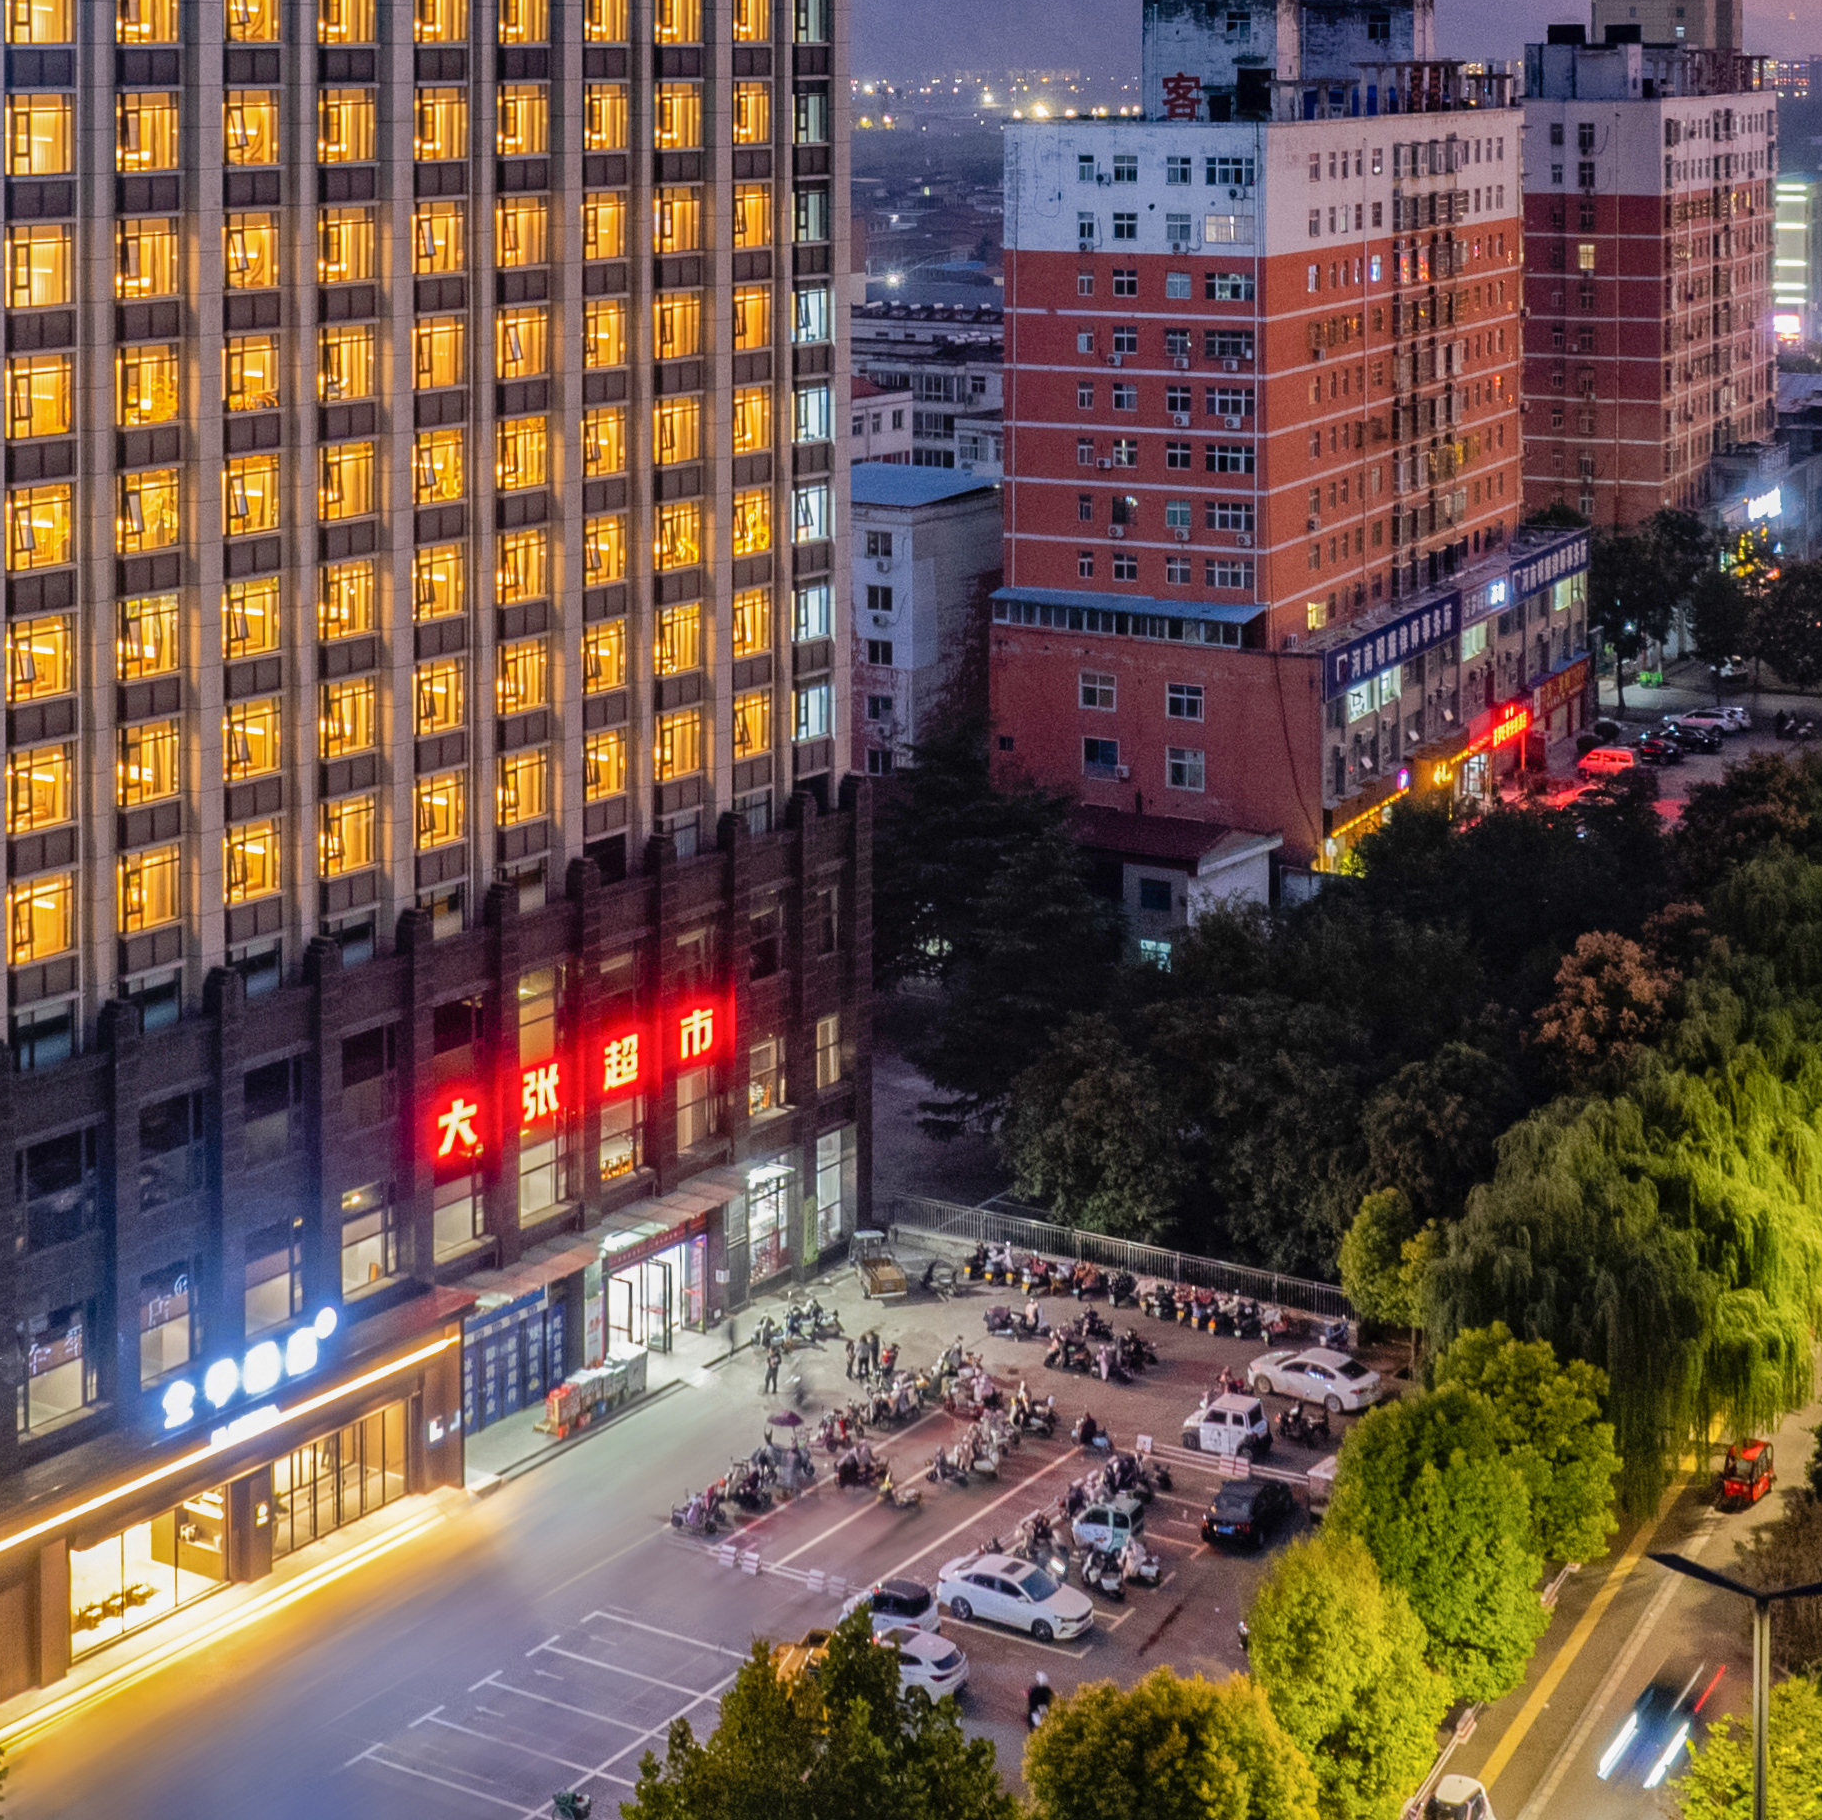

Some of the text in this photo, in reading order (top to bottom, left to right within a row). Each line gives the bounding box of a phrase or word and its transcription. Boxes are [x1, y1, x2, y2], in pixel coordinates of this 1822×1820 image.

[1162, 72, 1202, 120] 客
[437, 1006, 715, 1157] 大张超市
